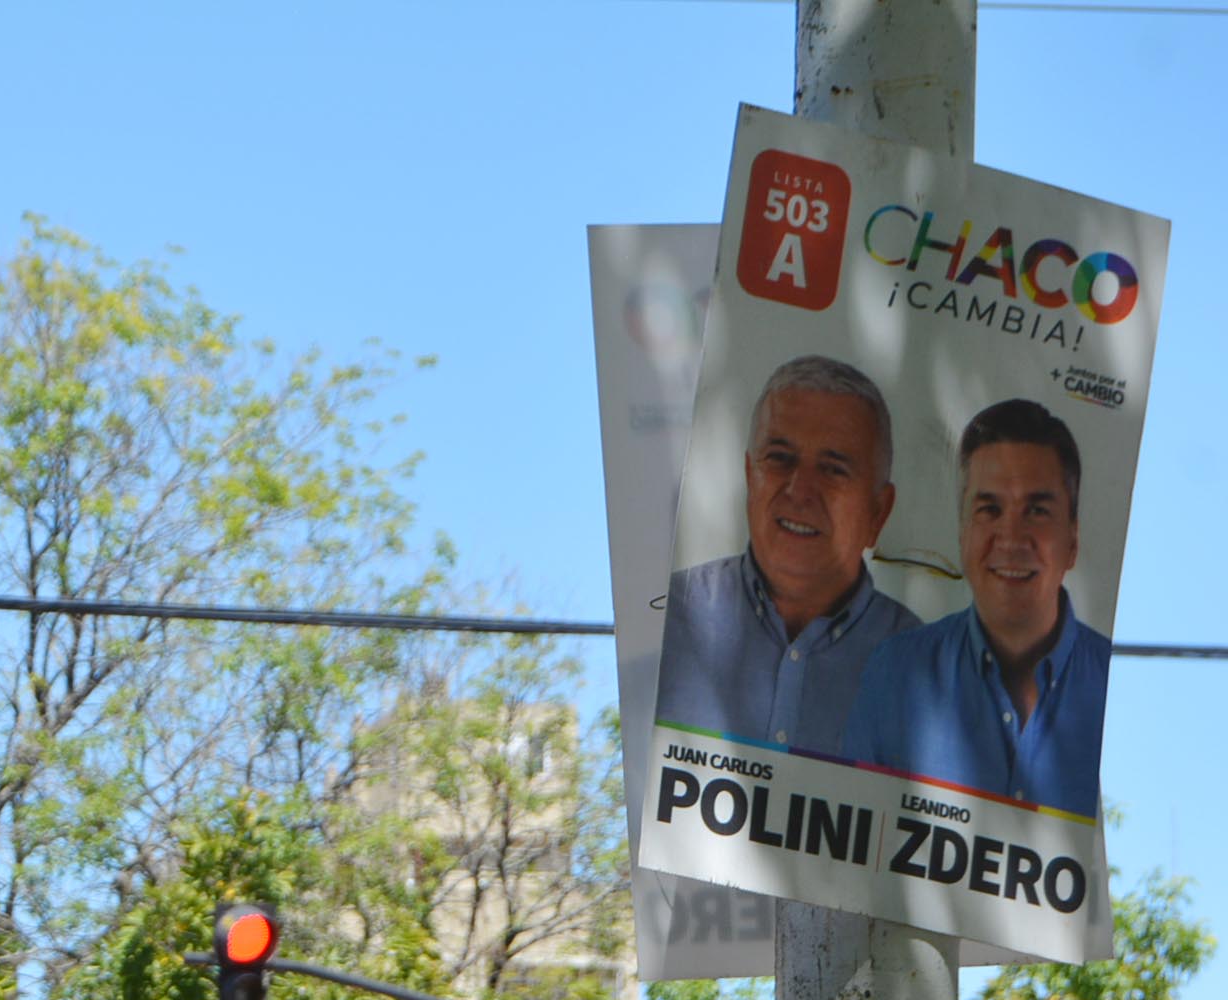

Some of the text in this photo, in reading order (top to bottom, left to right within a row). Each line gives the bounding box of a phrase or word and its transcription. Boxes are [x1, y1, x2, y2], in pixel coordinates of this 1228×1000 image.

[774, 171, 823, 193] LISTA
[763, 188, 829, 233] 503
[766, 232, 808, 289] A
[864, 204, 1139, 325] CHACO
[888, 281, 1084, 352] ¡CAMBIA!
[1064, 376, 1124, 405] CAMBIO
[663, 744, 773, 780] JUAN CARLOS
[657, 766, 873, 865] POLINI
[901, 793, 970, 823] LEANDRO
[889, 816, 1086, 914] ZDERO
